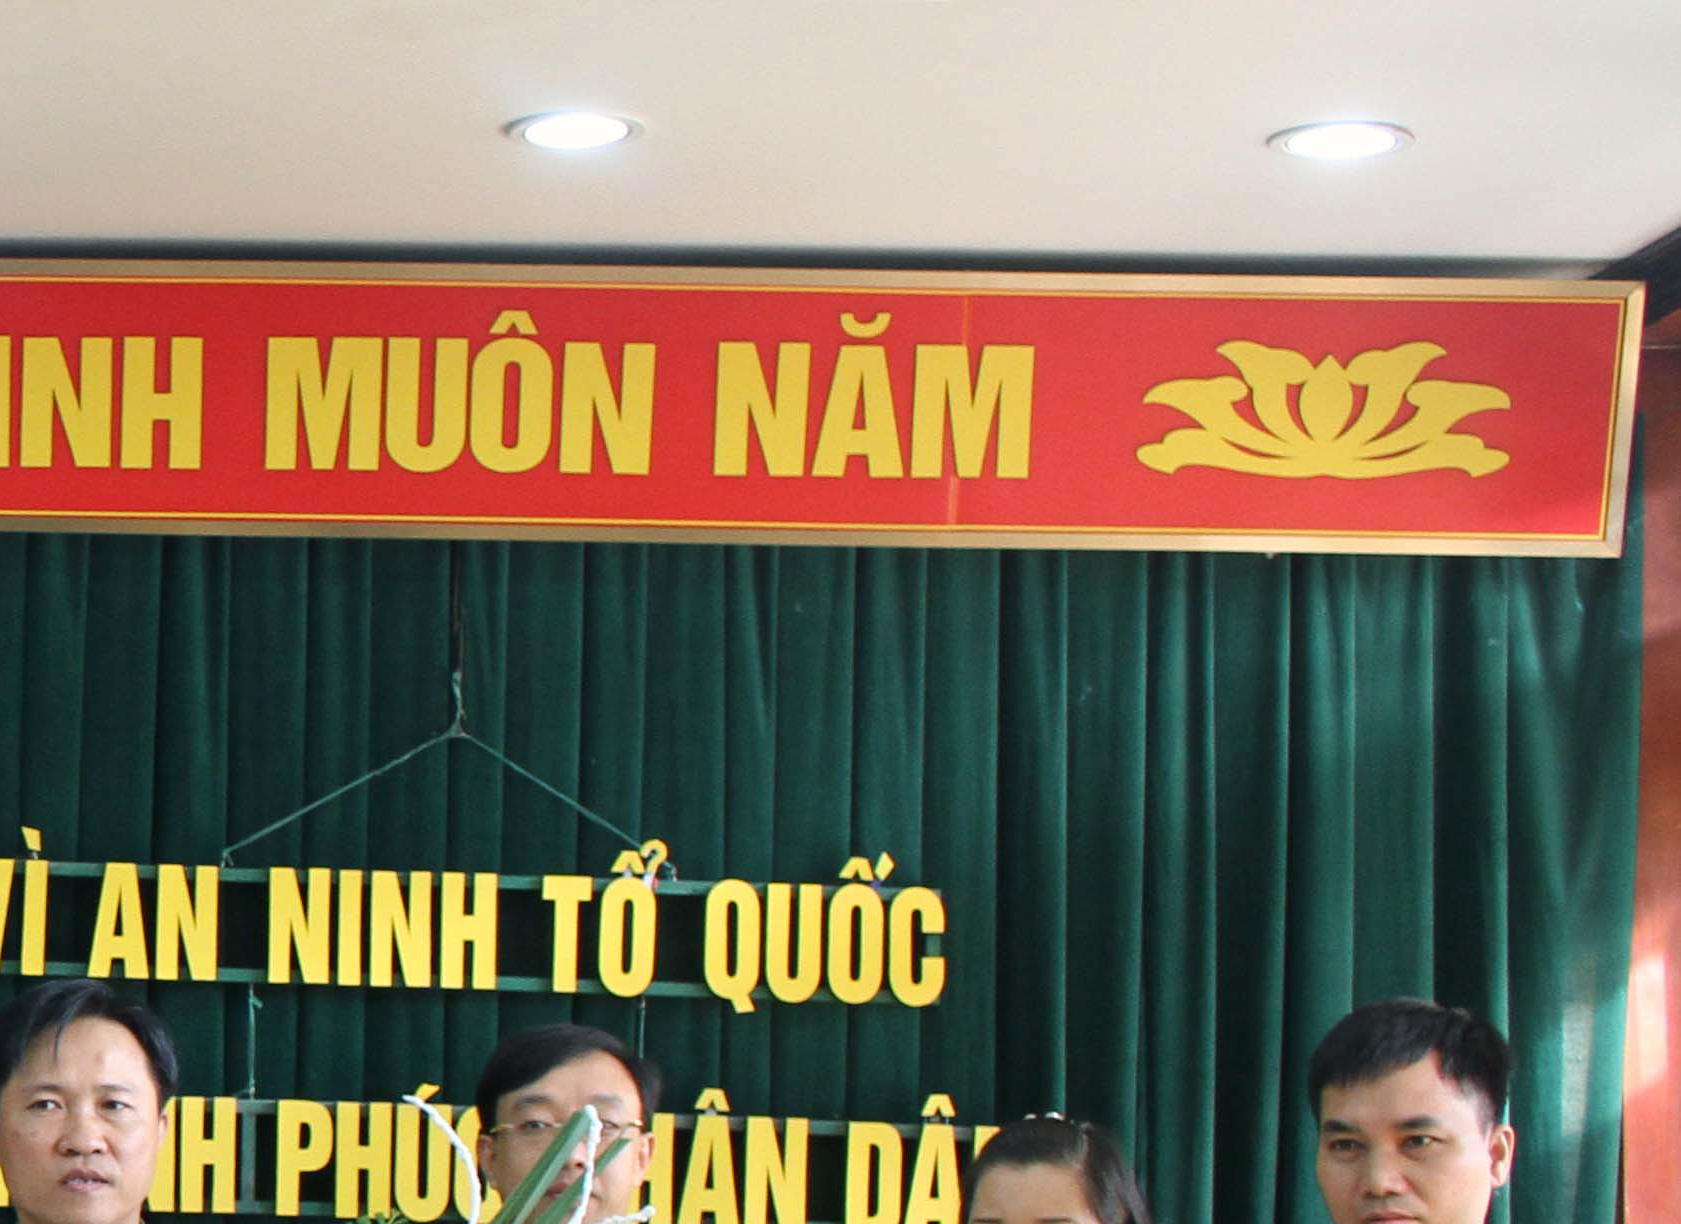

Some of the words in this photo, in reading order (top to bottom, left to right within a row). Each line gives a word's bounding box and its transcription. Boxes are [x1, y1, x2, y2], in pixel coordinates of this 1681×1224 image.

[265, 311, 655, 475] MUÔN
[713, 313, 1033, 477] NĂM
[87, 861, 221, 982] AN
[269, 866, 500, 990] NINH
[545, 838, 670, 998] TỔ
[705, 853, 946, 1014] QUỐC
